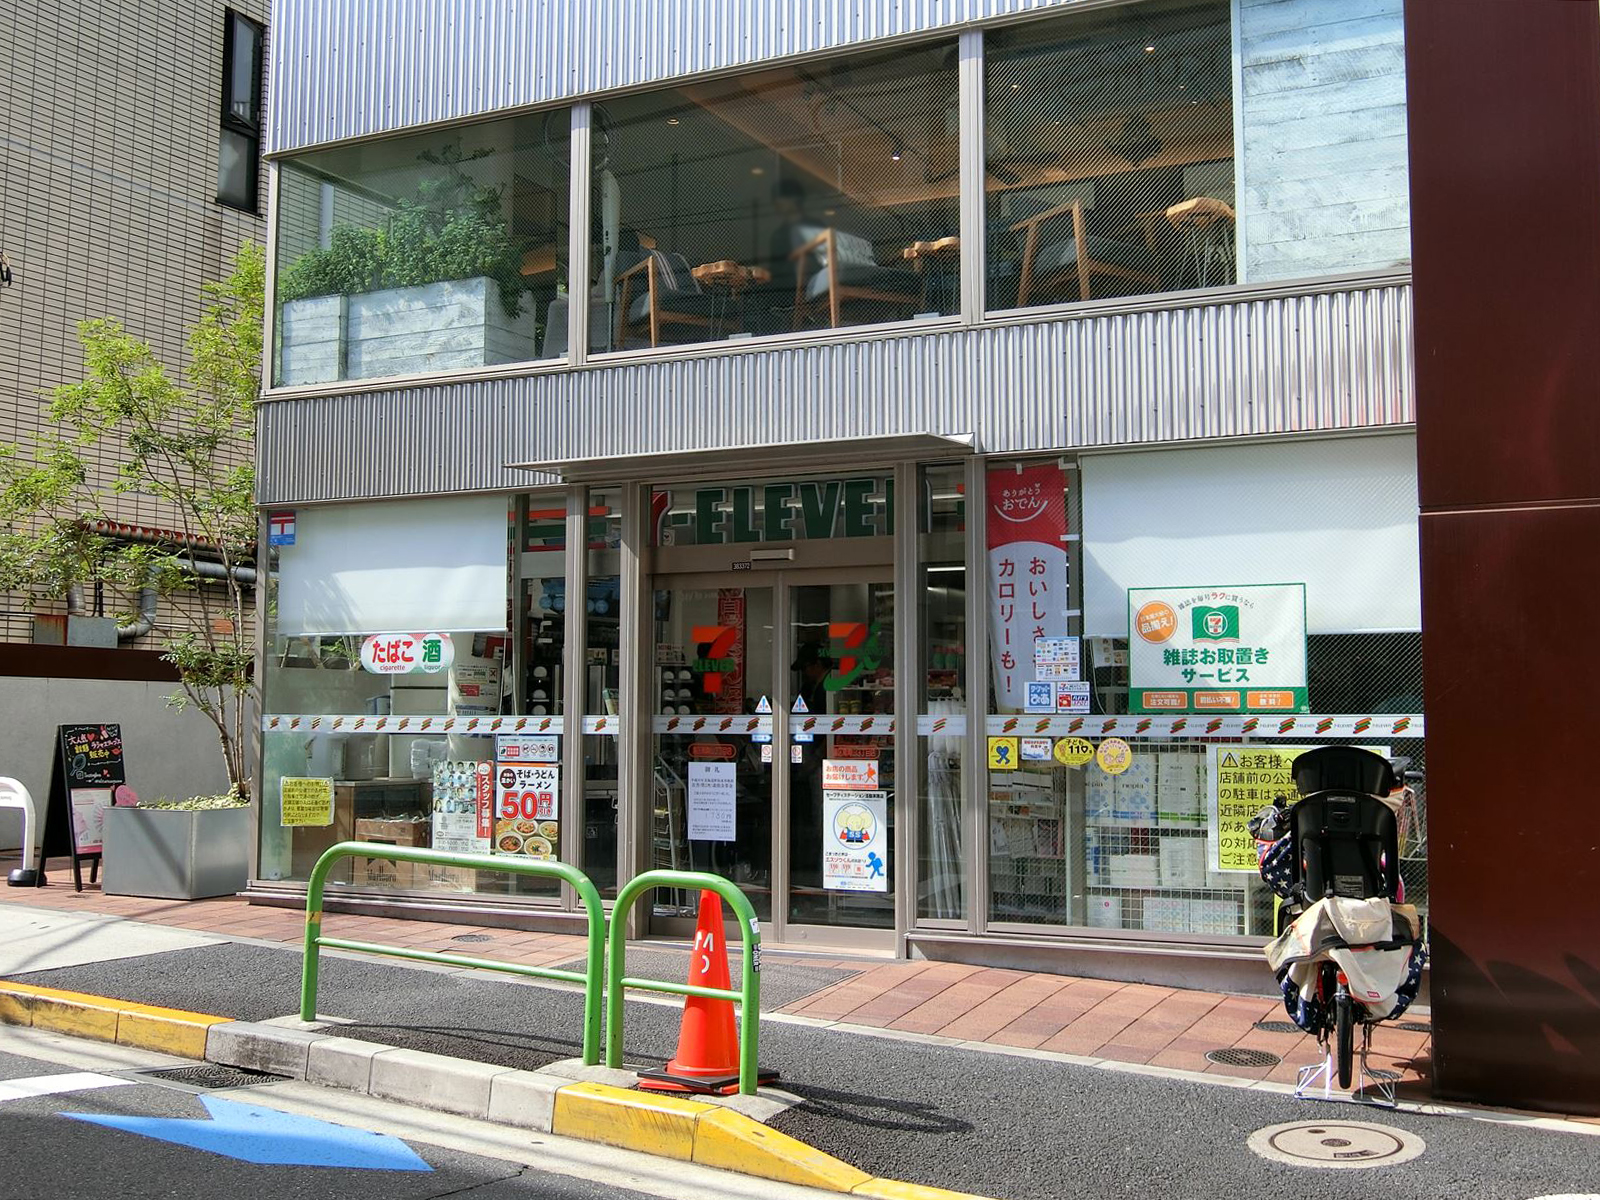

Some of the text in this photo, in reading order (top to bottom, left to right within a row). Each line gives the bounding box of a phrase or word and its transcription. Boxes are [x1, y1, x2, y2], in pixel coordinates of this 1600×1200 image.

[1003, 487, 1041, 496] ありがとう
[1002, 497, 1041, 511] おでん
[652, 477, 894, 547] -ELEVE
[1029, 557, 1047, 668] おいしさ
[999, 558, 1015, 693] カロリーも!
[372, 639, 442, 663] たばこ 酒
[1163, 647, 1270, 666] 雑誌お取置き
[379, 664, 405, 672] cigarette
[1181, 667, 1250, 684] サービス
[1030, 693, 1050, 705] ぴあ
[1066, 738, 1084, 746] 子ども
[516, 769, 555, 779] そば・うどん
[519, 780, 552, 790] ラーメン
[1220, 788, 1306, 801] の駐車は交通
[500, 790, 538, 820] 50
[1220, 804, 1267, 817] 近隣店
